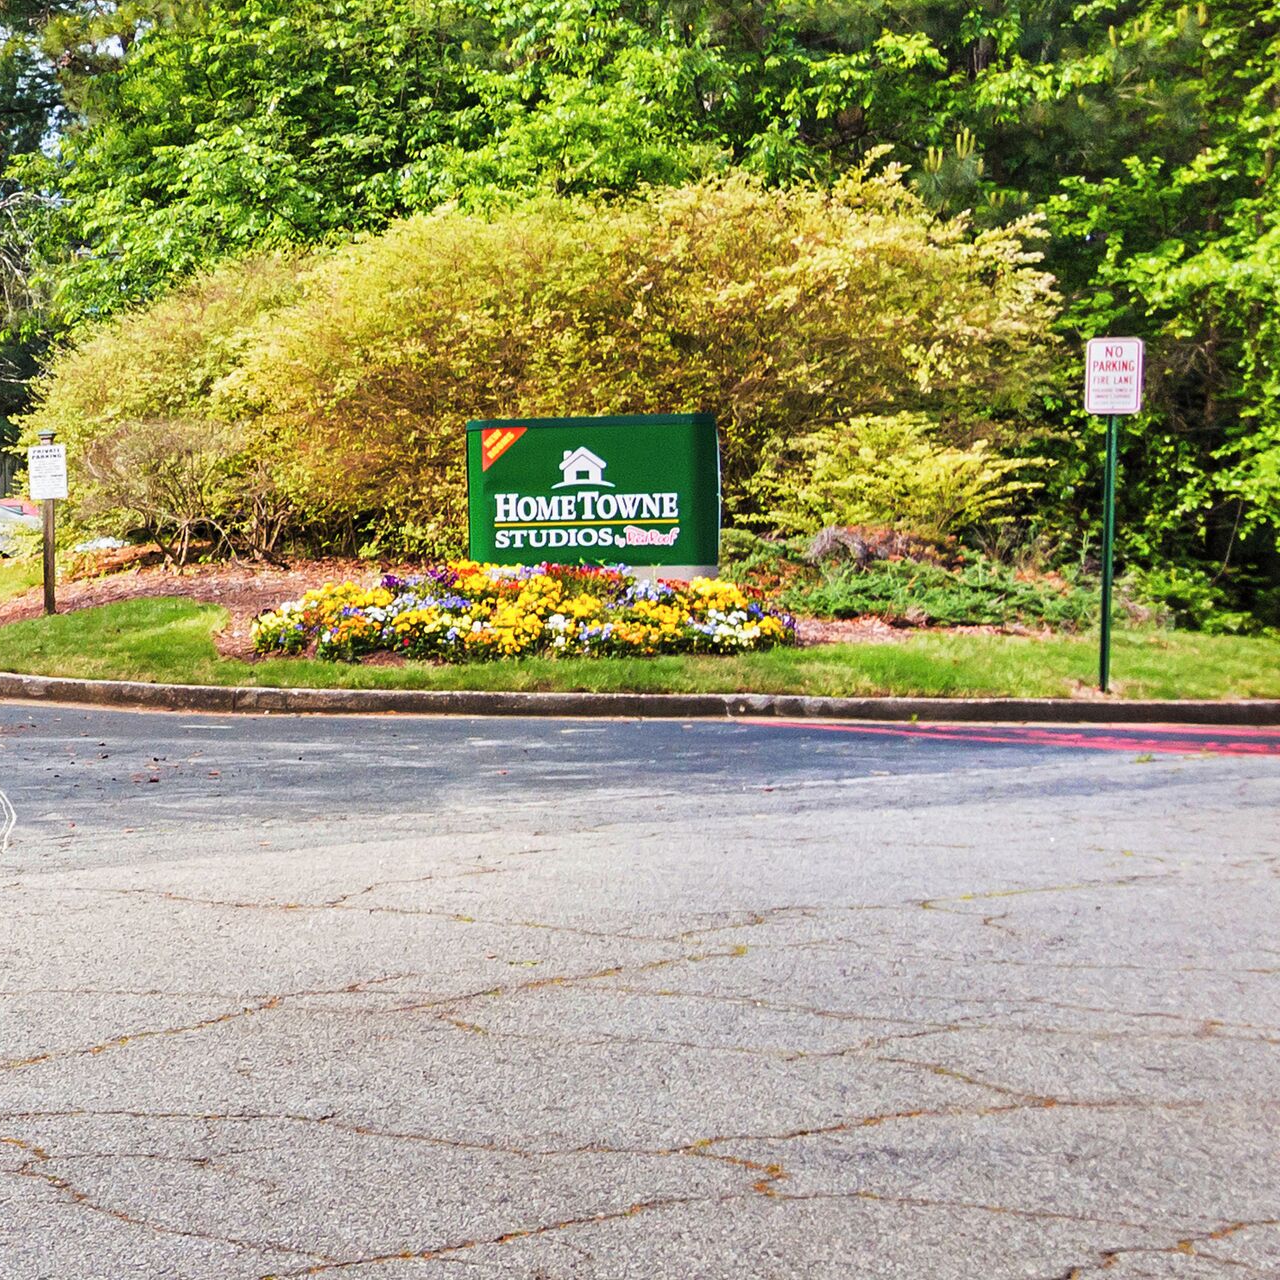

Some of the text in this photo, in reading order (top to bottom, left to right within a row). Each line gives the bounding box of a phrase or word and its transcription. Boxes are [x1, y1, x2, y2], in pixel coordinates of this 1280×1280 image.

[1105, 346, 1123, 358] NO
[1093, 360, 1135, 372] PARKING
[1093, 376, 1132, 385] FIRE LANE
[495, 528, 614, 548] STUDIOS
[614, 534, 626, 548] by
